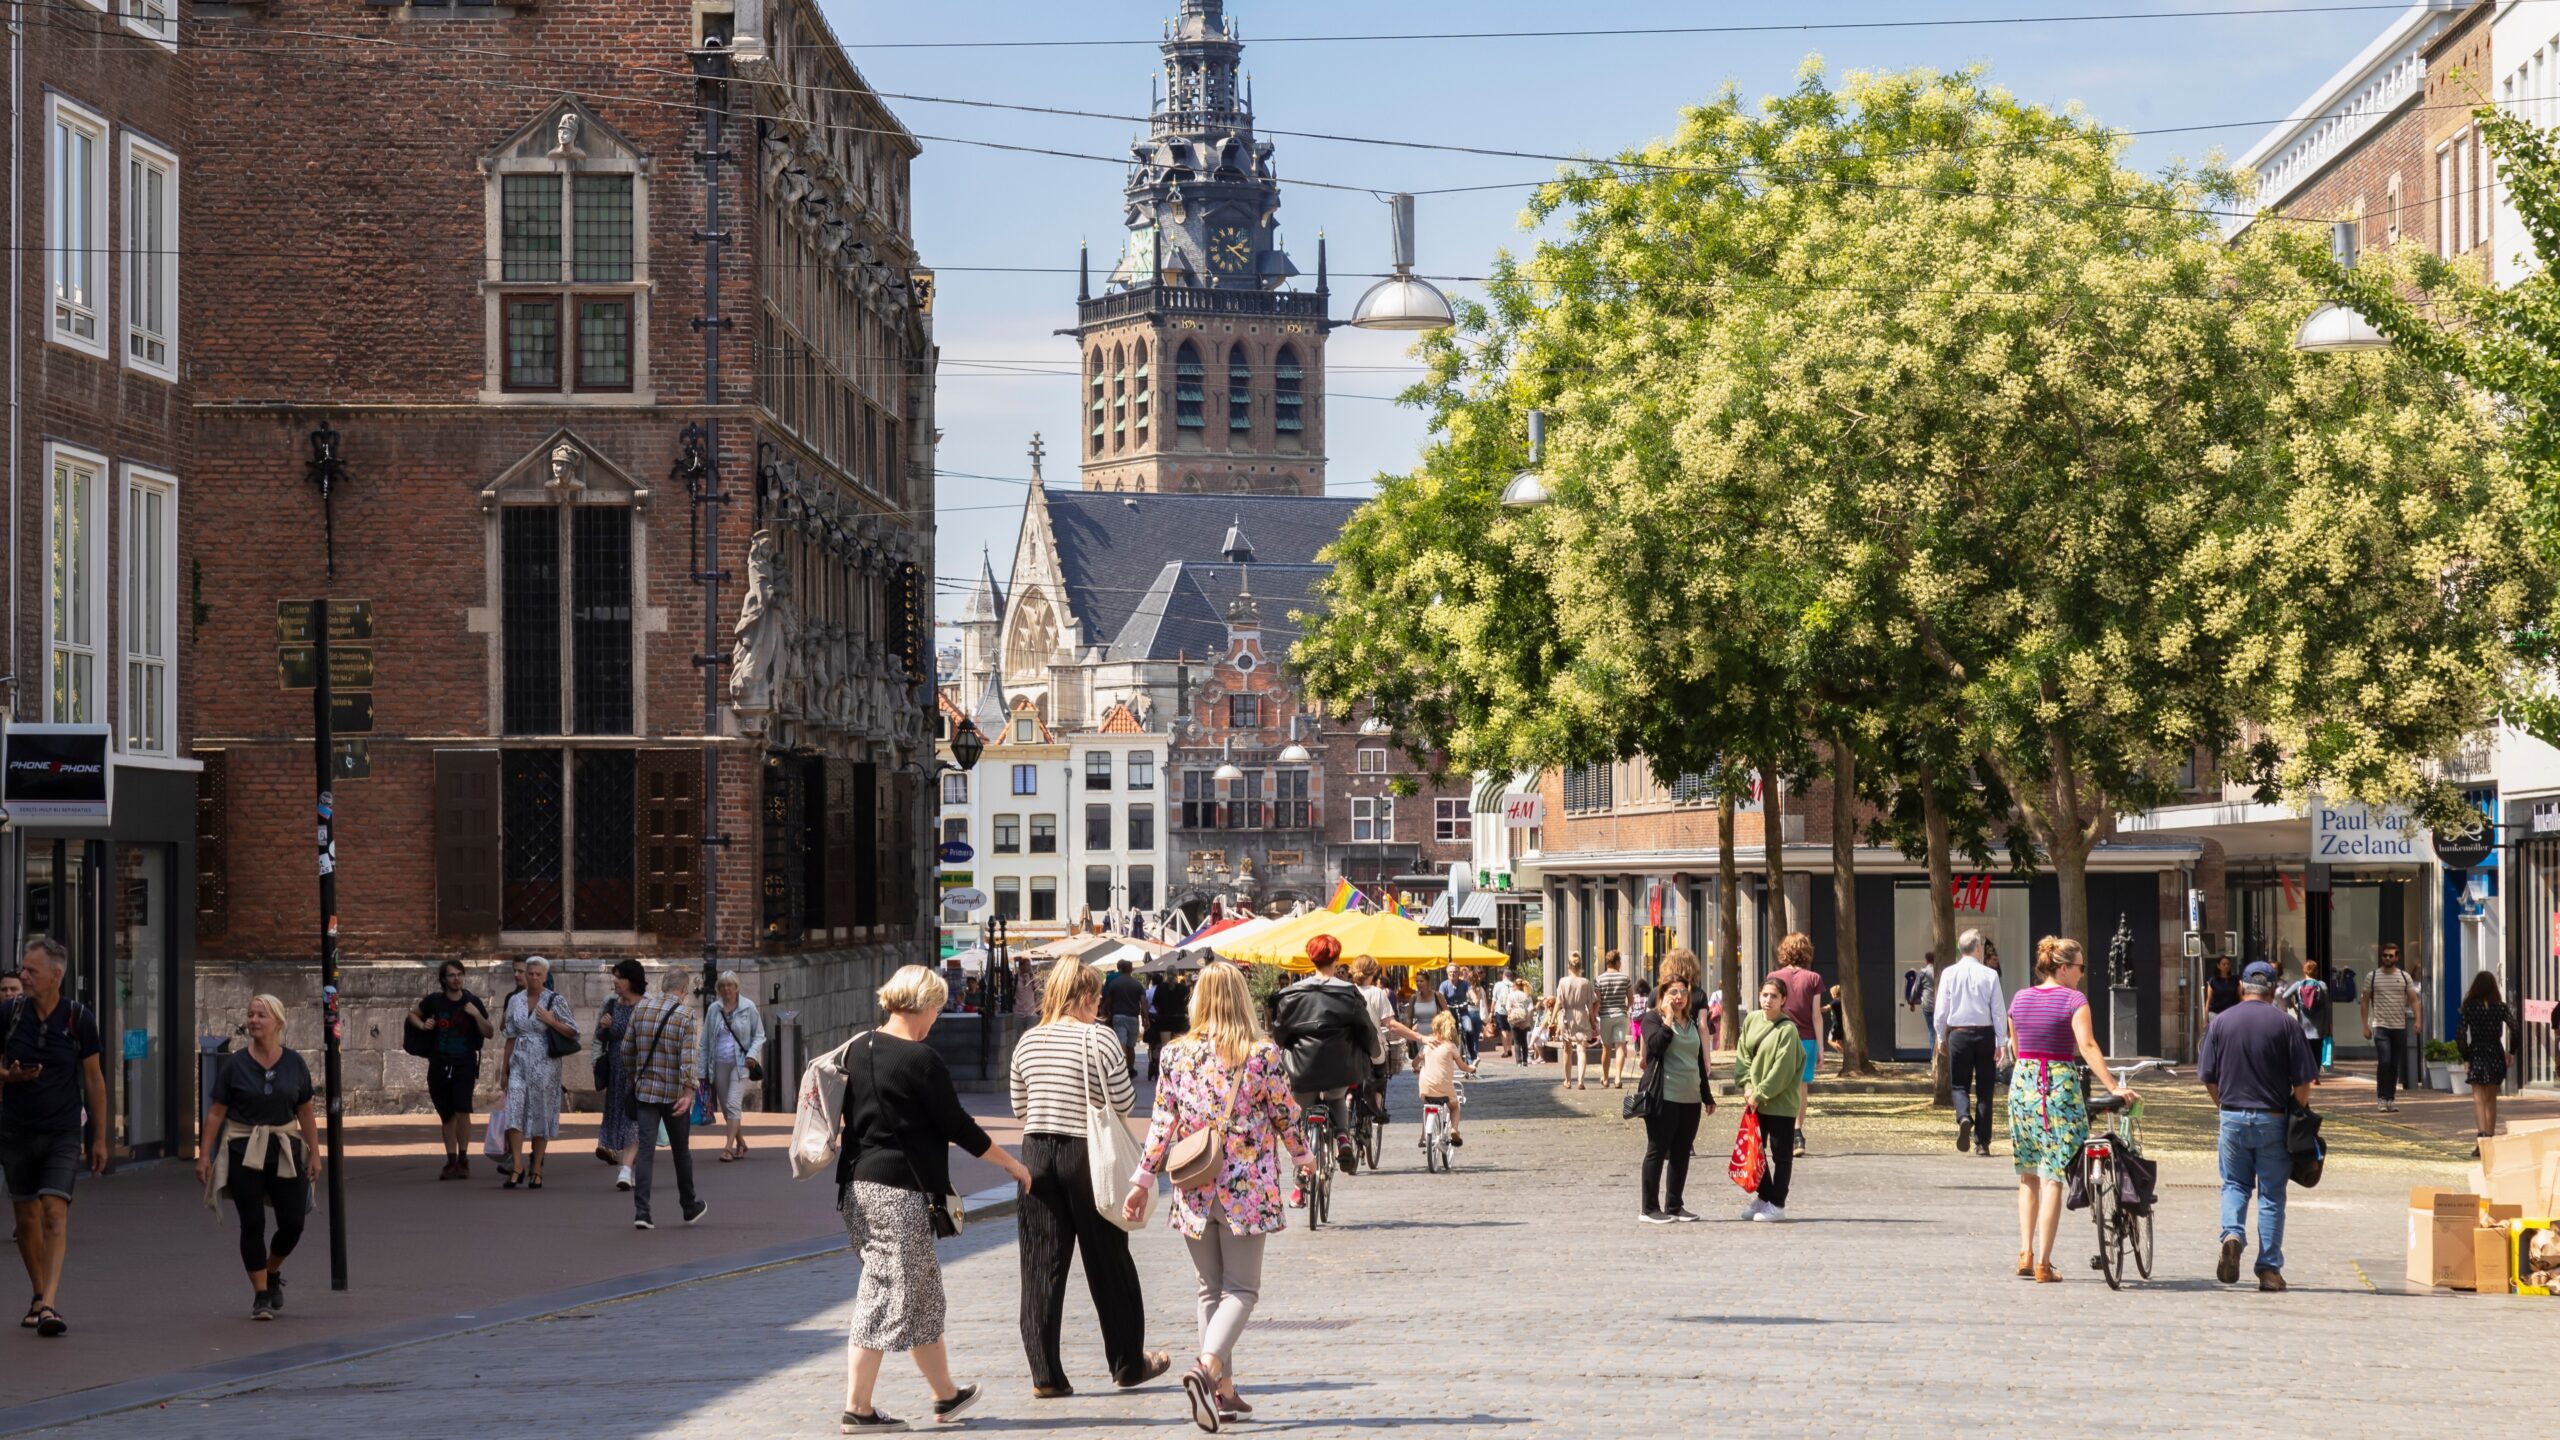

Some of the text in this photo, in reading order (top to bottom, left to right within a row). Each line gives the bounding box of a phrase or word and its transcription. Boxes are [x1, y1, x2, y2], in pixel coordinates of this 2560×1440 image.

[9, 761, 101, 773] PHONE PHONE
[1507, 801, 1535, 819] H&M
[2320, 810, 2368, 831] Paul
[2320, 834, 2412, 855] Zeeland
[2438, 843, 2490, 853] hunkemöller
[949, 848, 973, 857] Primera
[946, 894, 981, 908] Triumph
